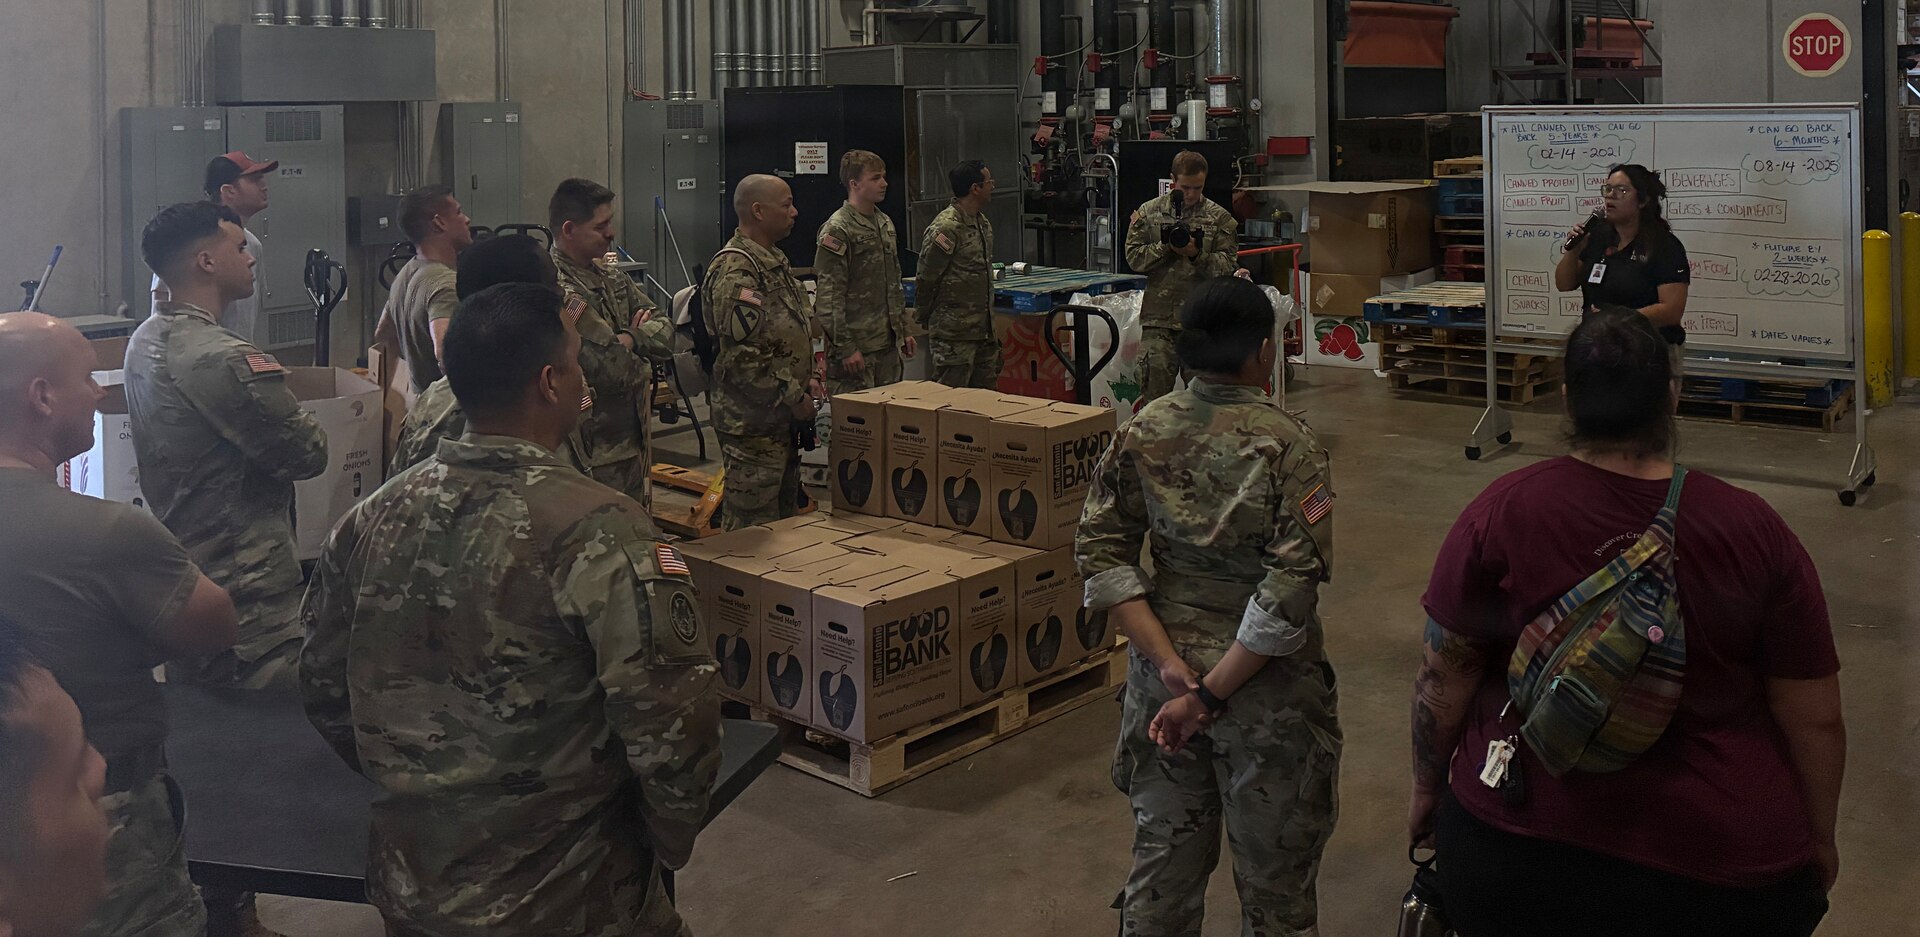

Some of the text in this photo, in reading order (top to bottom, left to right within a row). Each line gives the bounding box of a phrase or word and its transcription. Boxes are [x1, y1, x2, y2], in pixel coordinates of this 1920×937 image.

[1792, 35, 1841, 56] STOP
[1511, 124, 1526, 133] ALL
[1531, 123, 1567, 132] CANNED
[1608, 123, 1625, 131] CAN
[1758, 123, 1836, 134] CAN GO BACK
[1516, 133, 1537, 142] BACK
[1506, 178, 1575, 190] CANNED PROTEIN
[1671, 171, 1735, 188] BEVERAGES
[1540, 195, 1566, 206] FRUIT
[1668, 201, 1702, 216] GLASS
[1716, 202, 1783, 218] CONDIMENTS
[1515, 229, 1536, 239] CAN
[1537, 229, 1551, 238] GO
[1764, 243, 1801, 253] FUTURE
[1511, 275, 1548, 287] CEREAL
[1753, 268, 1831, 287] 02-28-2026
[1512, 299, 1548, 312] SNACKS
[1760, 330, 1822, 344] DATES VARIES
[839, 424, 872, 437] Need Help?
[893, 432, 927, 445] Need Help?
[965, 443, 987, 454] Ayuda?
[1062, 430, 1112, 465] FOOD
[345, 449, 368, 461] FRESH
[991, 451, 1019, 463] ¿Necesita
[1019, 454, 1042, 466] Ayuda?
[342, 458, 372, 472] ONIONS
[1053, 444, 1062, 498] San Antonio
[1062, 456, 1101, 490] BAN
[1593, 531, 1642, 557] Discover Cre
[970, 602, 988, 614] Need
[988, 595, 1006, 607] Help?
[768, 611, 783, 623] Need
[783, 615, 802, 628] Help?
[885, 605, 950, 649] FOOD
[820, 629, 837, 640] Need
[837, 633, 856, 647] Help?
[873, 626, 884, 687] San Antonio
[885, 630, 951, 676] BANK
